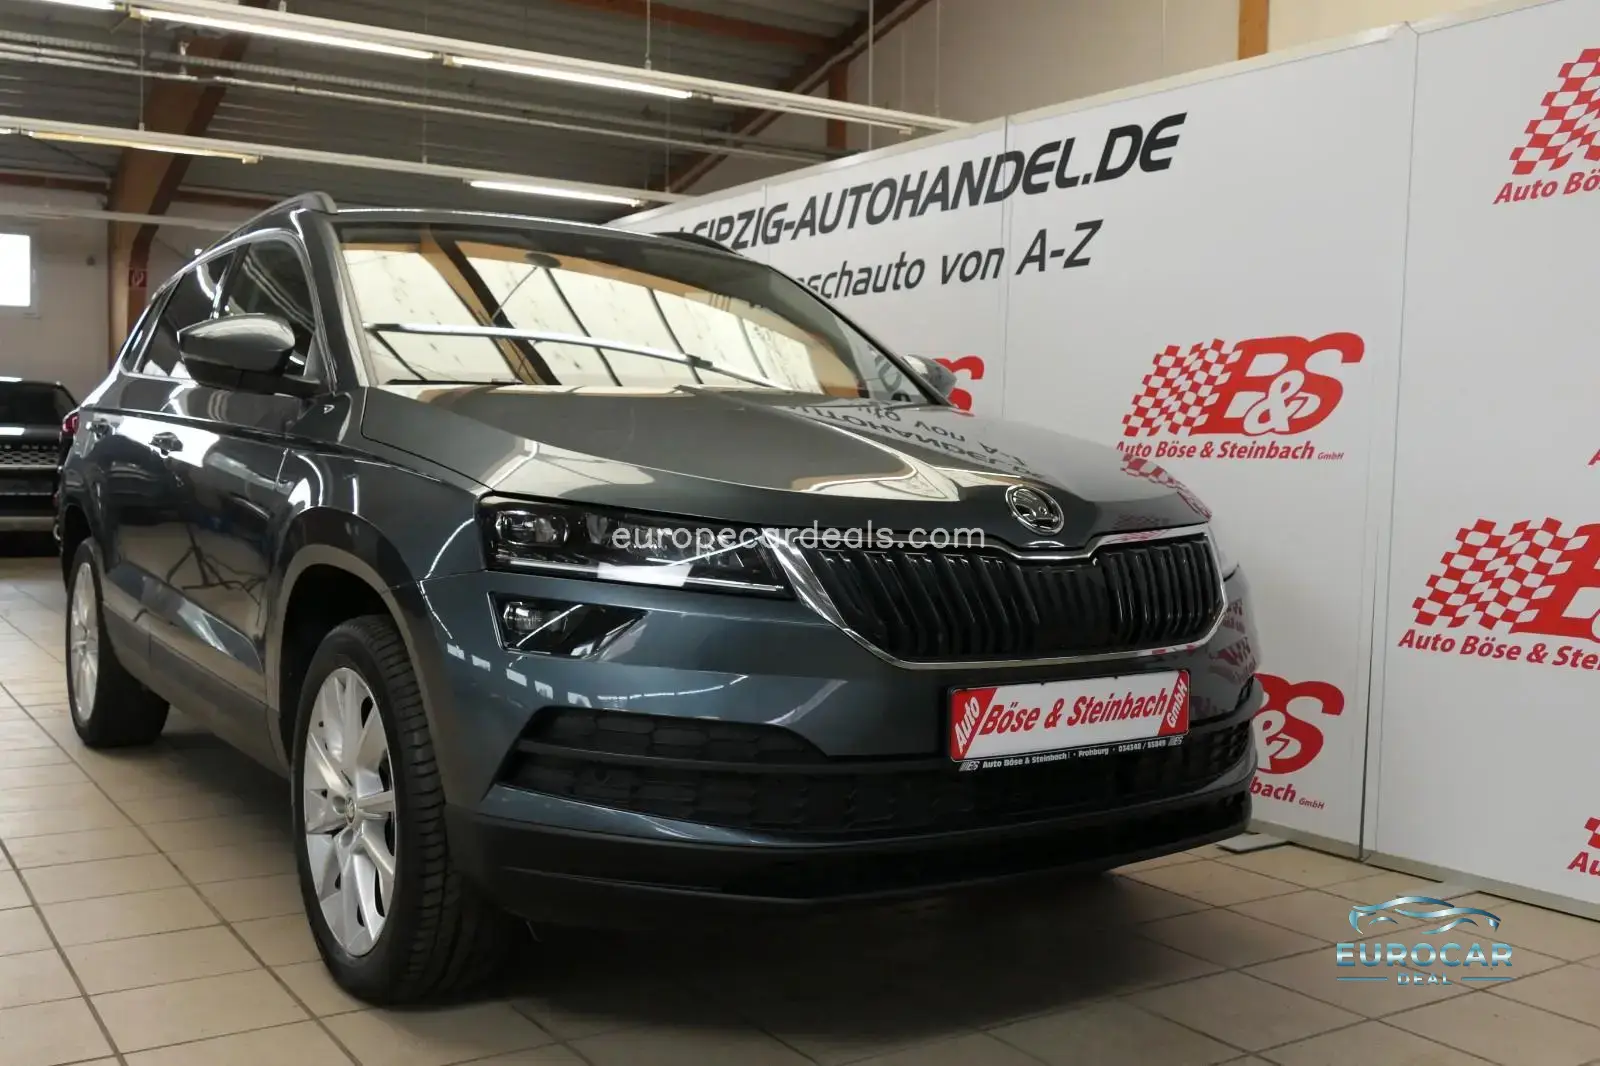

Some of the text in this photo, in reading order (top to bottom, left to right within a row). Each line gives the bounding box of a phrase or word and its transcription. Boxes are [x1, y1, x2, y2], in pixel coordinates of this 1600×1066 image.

[679, 112, 1187, 250] IPZIG-AUTOHANDEL.DE
[1492, 168, 1600, 205] Auto Bö
[798, 219, 1104, 299] schauto von A-Z
[1155, 440, 1197, 459] Böse
[1200, 440, 1214, 459] &
[1217, 440, 1316, 460] Steinbach
[1317, 452, 1345, 461] GmbH
[1398, 628, 1600, 671] Auto Böse & Ste
[954, 696, 981, 755] Auto
[978, 687, 1169, 736] Böse & Steinbach
[1166, 678, 1188, 729] GmbH
[982, 760, 1002, 769] Auto
[1031, 751, 1067, 764] Steinbach
[1298, 797, 1325, 810] GmbH
